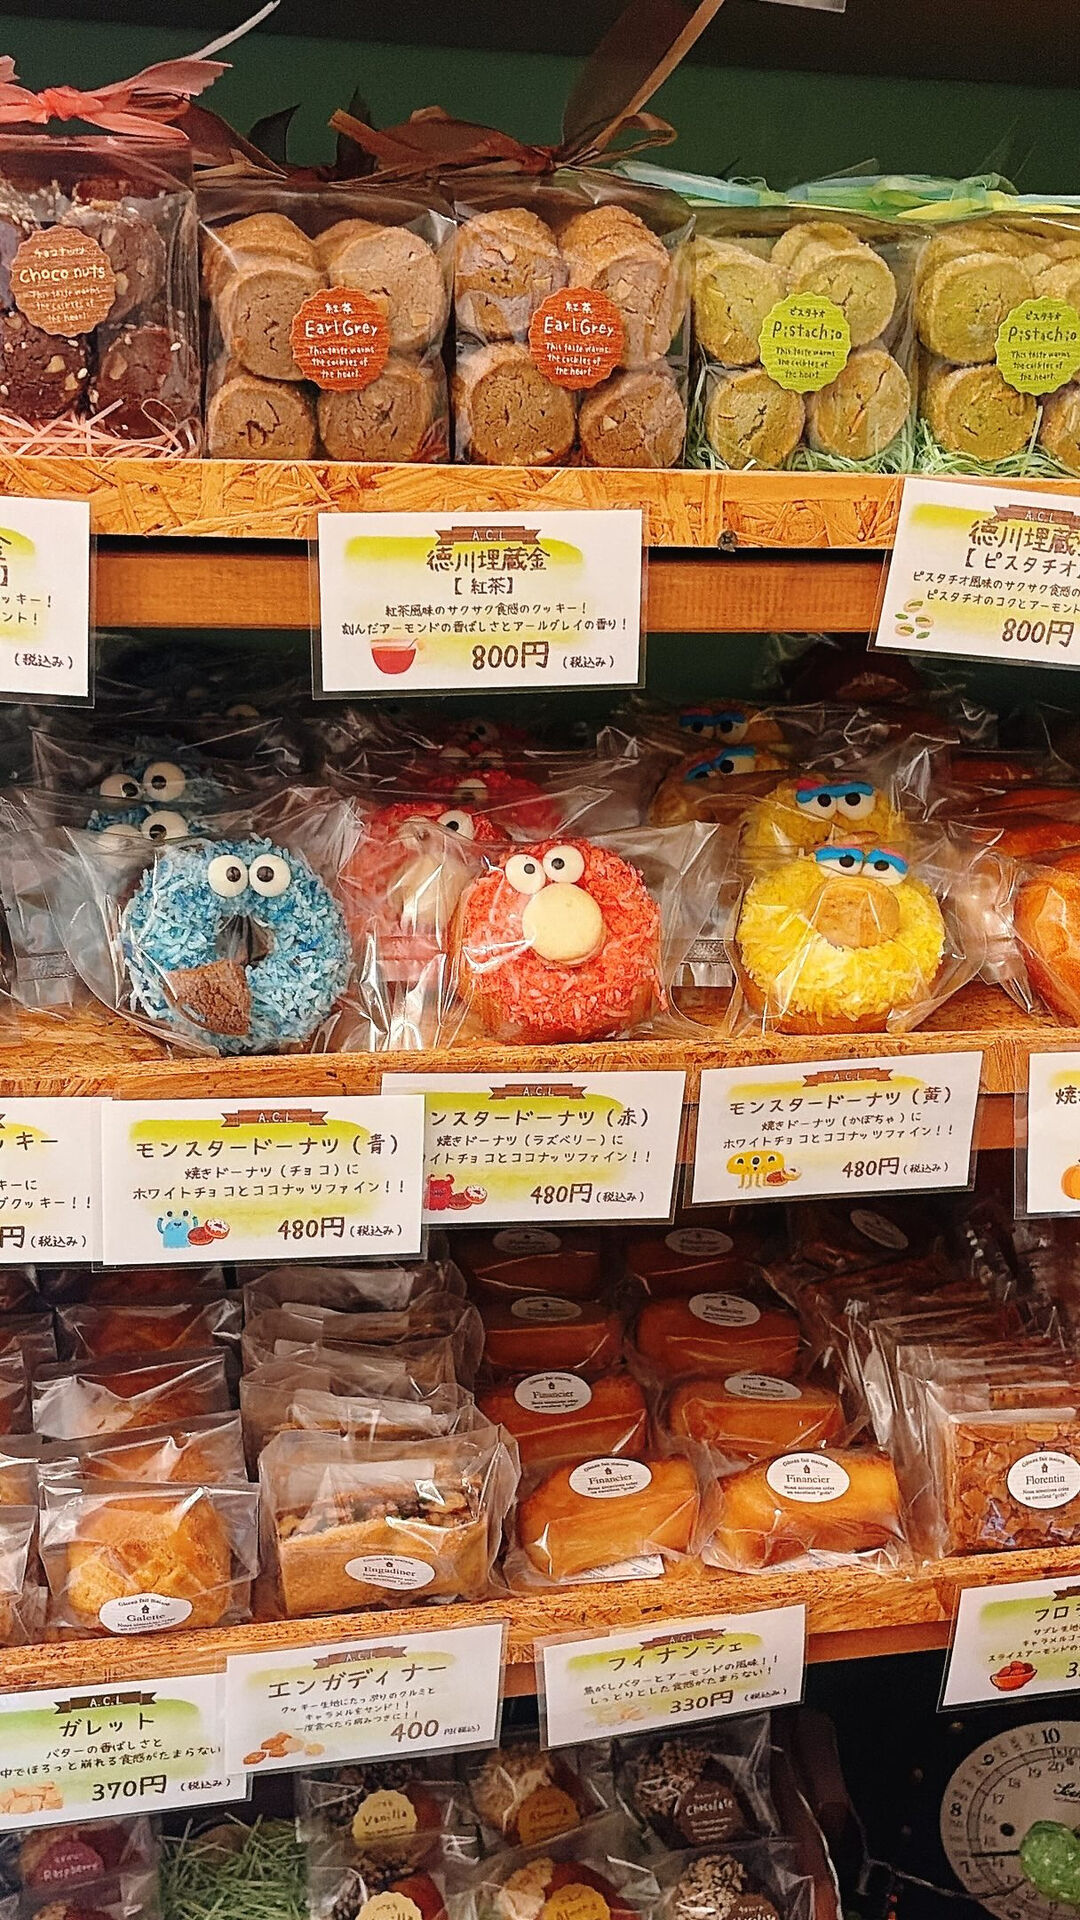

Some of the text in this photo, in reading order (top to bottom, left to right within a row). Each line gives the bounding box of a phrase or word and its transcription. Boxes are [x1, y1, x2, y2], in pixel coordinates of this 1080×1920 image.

[20, 264, 105, 283] Choco nuts
[305, 320, 378, 338] Earl Grey
[544, 316, 614, 337] Earl Grey
[772, 321, 842, 340] Pistachio
[1008, 326, 1077, 343] Pistachio
[969, 519, 1080, 556] 徳川埋蔵
[427, 547, 550, 573] 徳川埋蔵金
[965, 548, 1080, 579] 【ピスタチオ
[385, 602, 588, 618] 紅茶風味のサクサク食感のクッキー！
[1002, 618, 1075, 648] 800円
[14, 652, 74, 670] （税込み）
[472, 640, 615, 671] 800円 （税込み）
[729, 1086, 951, 1116] モンスタードーナツ（黄）
[1055, 1085, 1080, 1105] 焼
[761, 1112, 922, 1132] 焼きドーナツ（かぼちゃ）に
[0, 1131, 58, 1151] キー
[136, 1134, 400, 1158] モンスタードーナツ（青）
[436, 1134, 624, 1147] 焼きドーナツ（ラズベリー）に
[723, 1125, 953, 1149] ホワイトチョコとココナッツファイン！！
[424, 1151, 650, 1165] イトチョコとココナッツファイン！！
[842, 1157, 950, 1179] 480円 （税込み）
[184, 1163, 359, 1180] 焼きドーナツ（チョコ）に
[133, 1180, 405, 1200] ホワイトチョコとココナッツファイン！！
[530, 1183, 645, 1205] 480円 （税込み）
[278, 1216, 402, 1241] 480円 （税込み）
[30, 1235, 87, 1248] （税込み）
[589, 1474, 633, 1485] Financier
[786, 1474, 830, 1484] Financier
[1025, 1474, 1065, 1485] Florentin
[127, 1614, 165, 1622] Galette
[608, 1641, 743, 1671] フィナンシェ
[268, 1663, 447, 1698] エンガディナー
[670, 1690, 733, 1714] 330円
[59, 1712, 155, 1737] ガレット
[391, 1719, 440, 1742] 400
[1042, 1728, 1060, 1744] 10
[46, 1738, 163, 1759] バターの香ばしさと
[92, 1774, 167, 1801] 370円
[362, 1807, 407, 1826] Vanilla
[686, 1799, 733, 1816] Chocolate
[950, 1802, 961, 1817] 8
